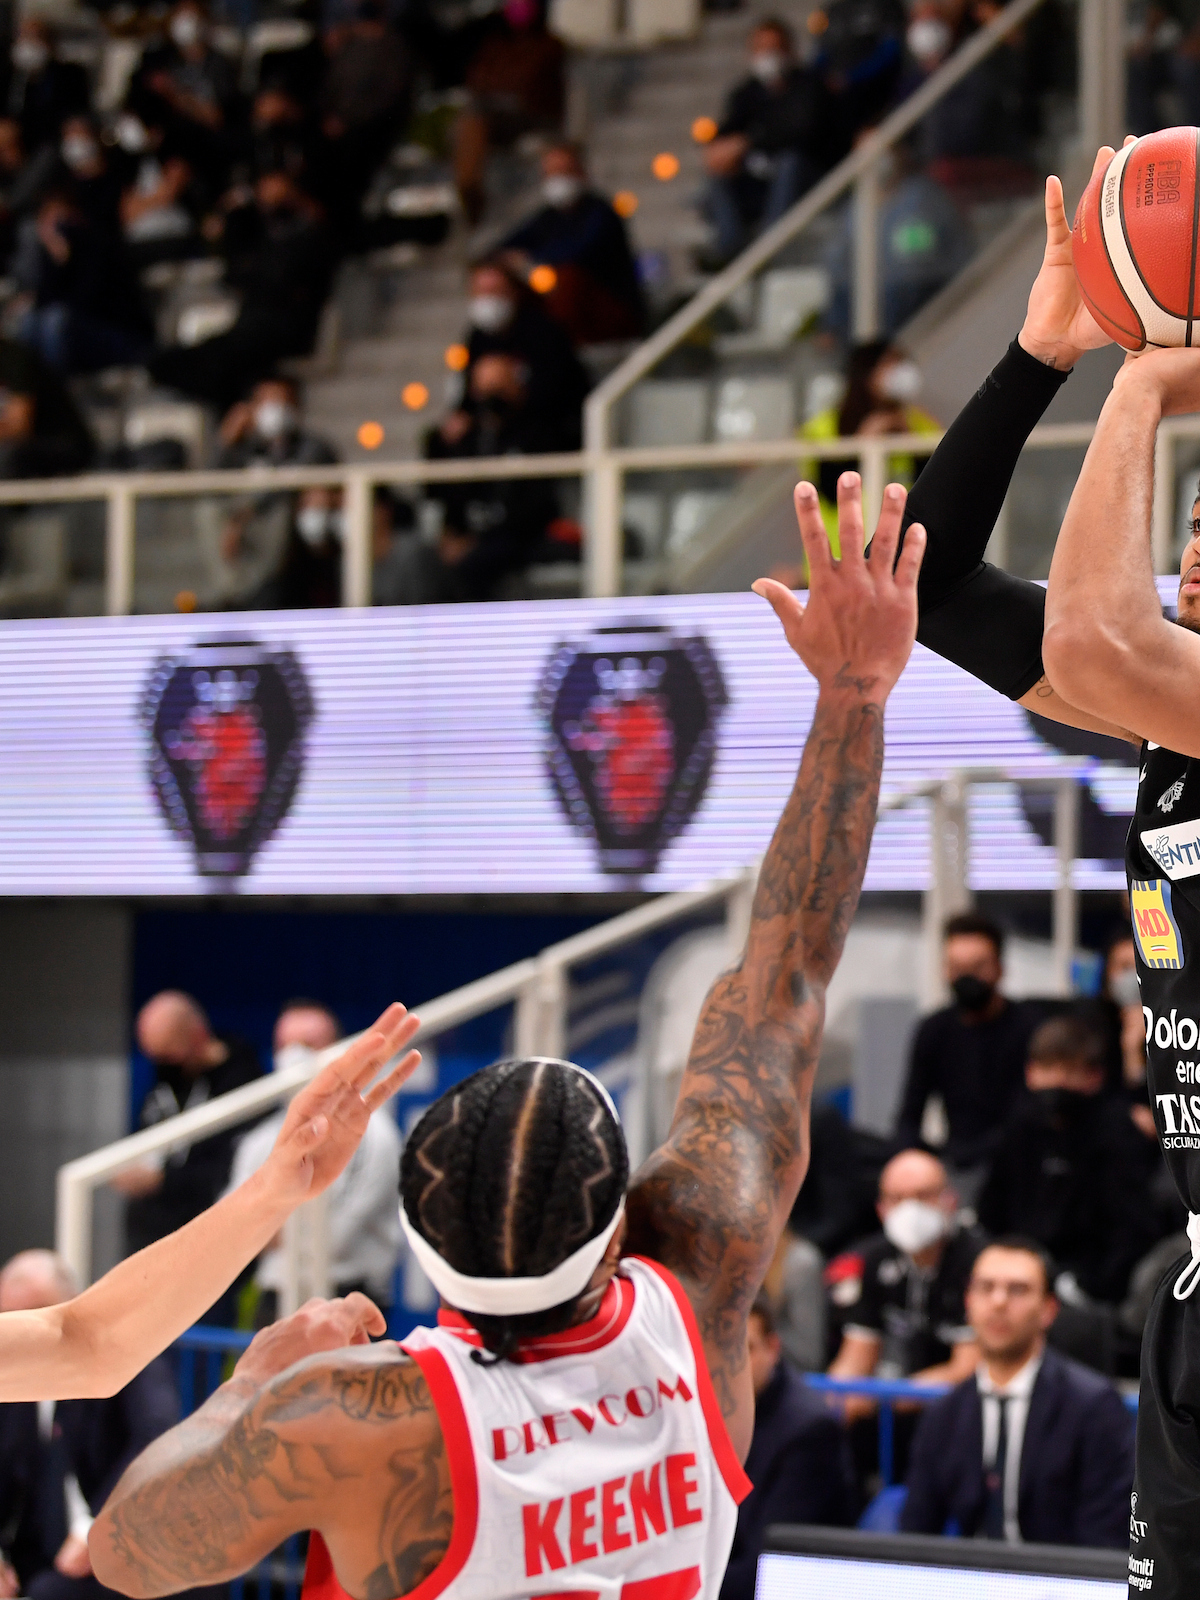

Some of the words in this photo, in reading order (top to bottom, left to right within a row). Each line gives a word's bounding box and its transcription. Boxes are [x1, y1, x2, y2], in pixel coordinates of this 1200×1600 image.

[1144, 163, 1155, 206] APPROVED
[1157, 160, 1182, 205] FIBA
[1135, 908, 1170, 939] MD
[491, 1375, 694, 1461] PREVCOM
[522, 1453, 703, 1577] KEENE
